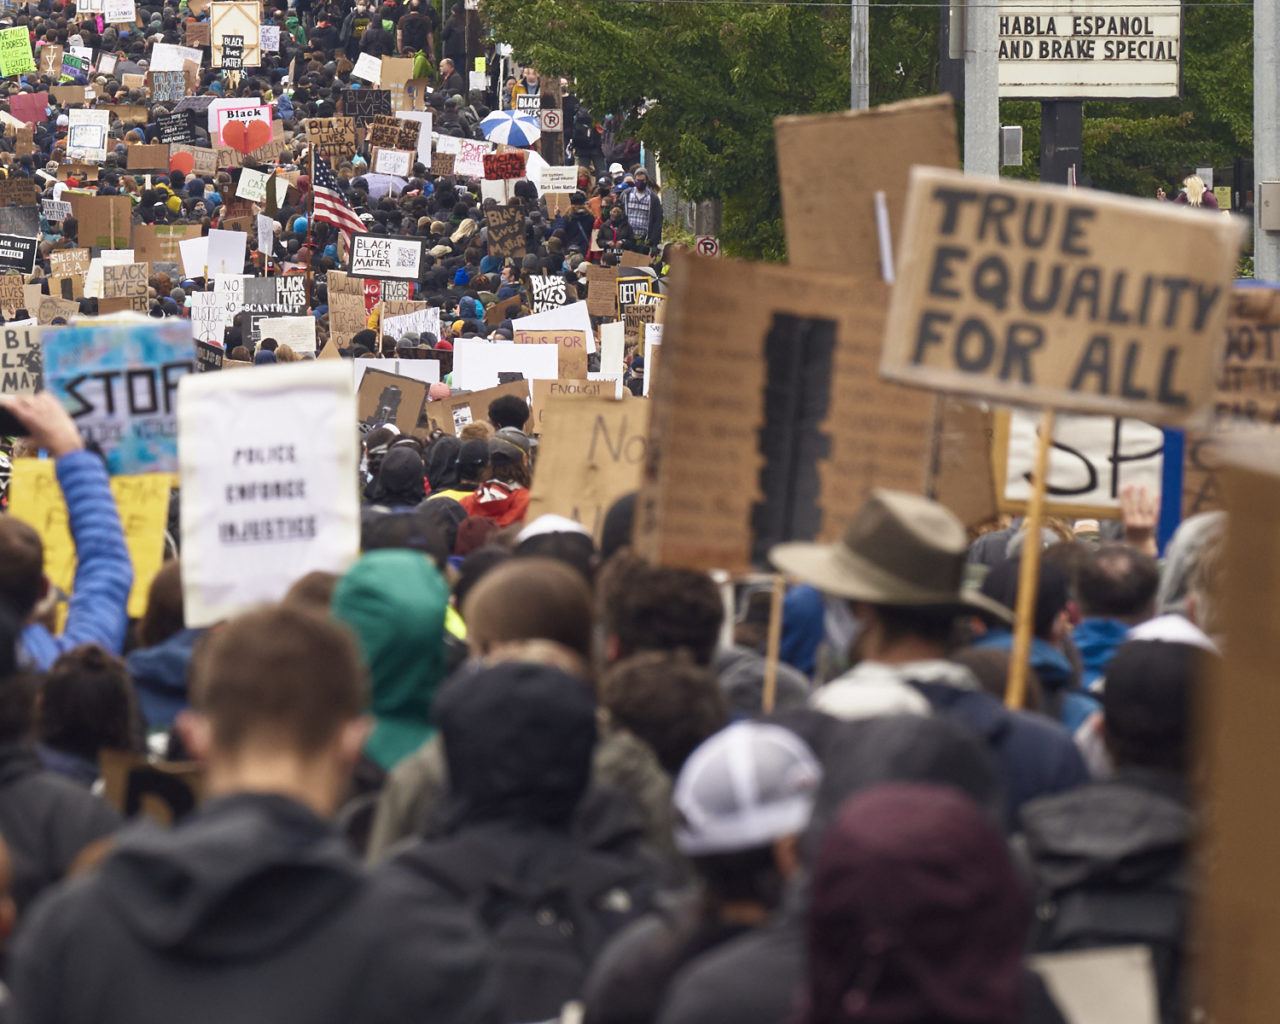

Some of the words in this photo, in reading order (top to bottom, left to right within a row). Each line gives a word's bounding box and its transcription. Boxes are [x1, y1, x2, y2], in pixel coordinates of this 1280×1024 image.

[999, 16, 1057, 35] HABLA
[1072, 16, 1154, 35] ESPANOL
[1, 39, 28, 51] ADDRESS
[224, 36, 243, 46] BLACK
[999, 40, 1033, 59] AND
[1039, 40, 1095, 59] BRAKE
[1104, 40, 1177, 59] SPECIAL
[222, 58, 241, 68] MATTER
[346, 90, 390, 103] BLACK
[227, 109, 262, 119] Black
[346, 103, 390, 116] LIVES
[309, 118, 356, 135] BLACK
[319, 134, 346, 144] LIVES
[461, 141, 487, 152] POWER
[485, 153, 521, 163] RACIAL
[485, 162, 525, 173] JUSTICE
[932, 186, 1098, 257] TRUE
[14, 242, 30, 250] LIVES
[356, 239, 391, 249] BLACK
[50, 248, 89, 263] SILENCE
[356, 249, 389, 258] LIVES
[62, 261, 73, 273] IS
[74, 261, 82, 273] A
[354, 259, 391, 268] MATTER
[104, 264, 148, 282] BLACK
[104, 279, 149, 297] LIVES
[223, 279, 240, 292] NO
[276, 276, 305, 291] BLACK
[530, 275, 566, 293] BLACK
[927, 246, 1221, 334] EQUALITY
[0, 287, 24, 298] LIVES
[276, 291, 306, 306] LIVES
[534, 284, 567, 304] LIVES
[201, 294, 216, 306] NO
[192, 306, 224, 321] JUSTICE
[201, 320, 217, 331] NO
[909, 312, 1045, 385] FOR
[1067, 332, 1191, 407] ALL
[64, 360, 193, 420] STOP
[550, 383, 600, 394] ENOUGH
[233, 444, 298, 468] POLICE
[224, 478, 307, 506] ENFORCE
[218, 515, 317, 544] INJUSTICE
